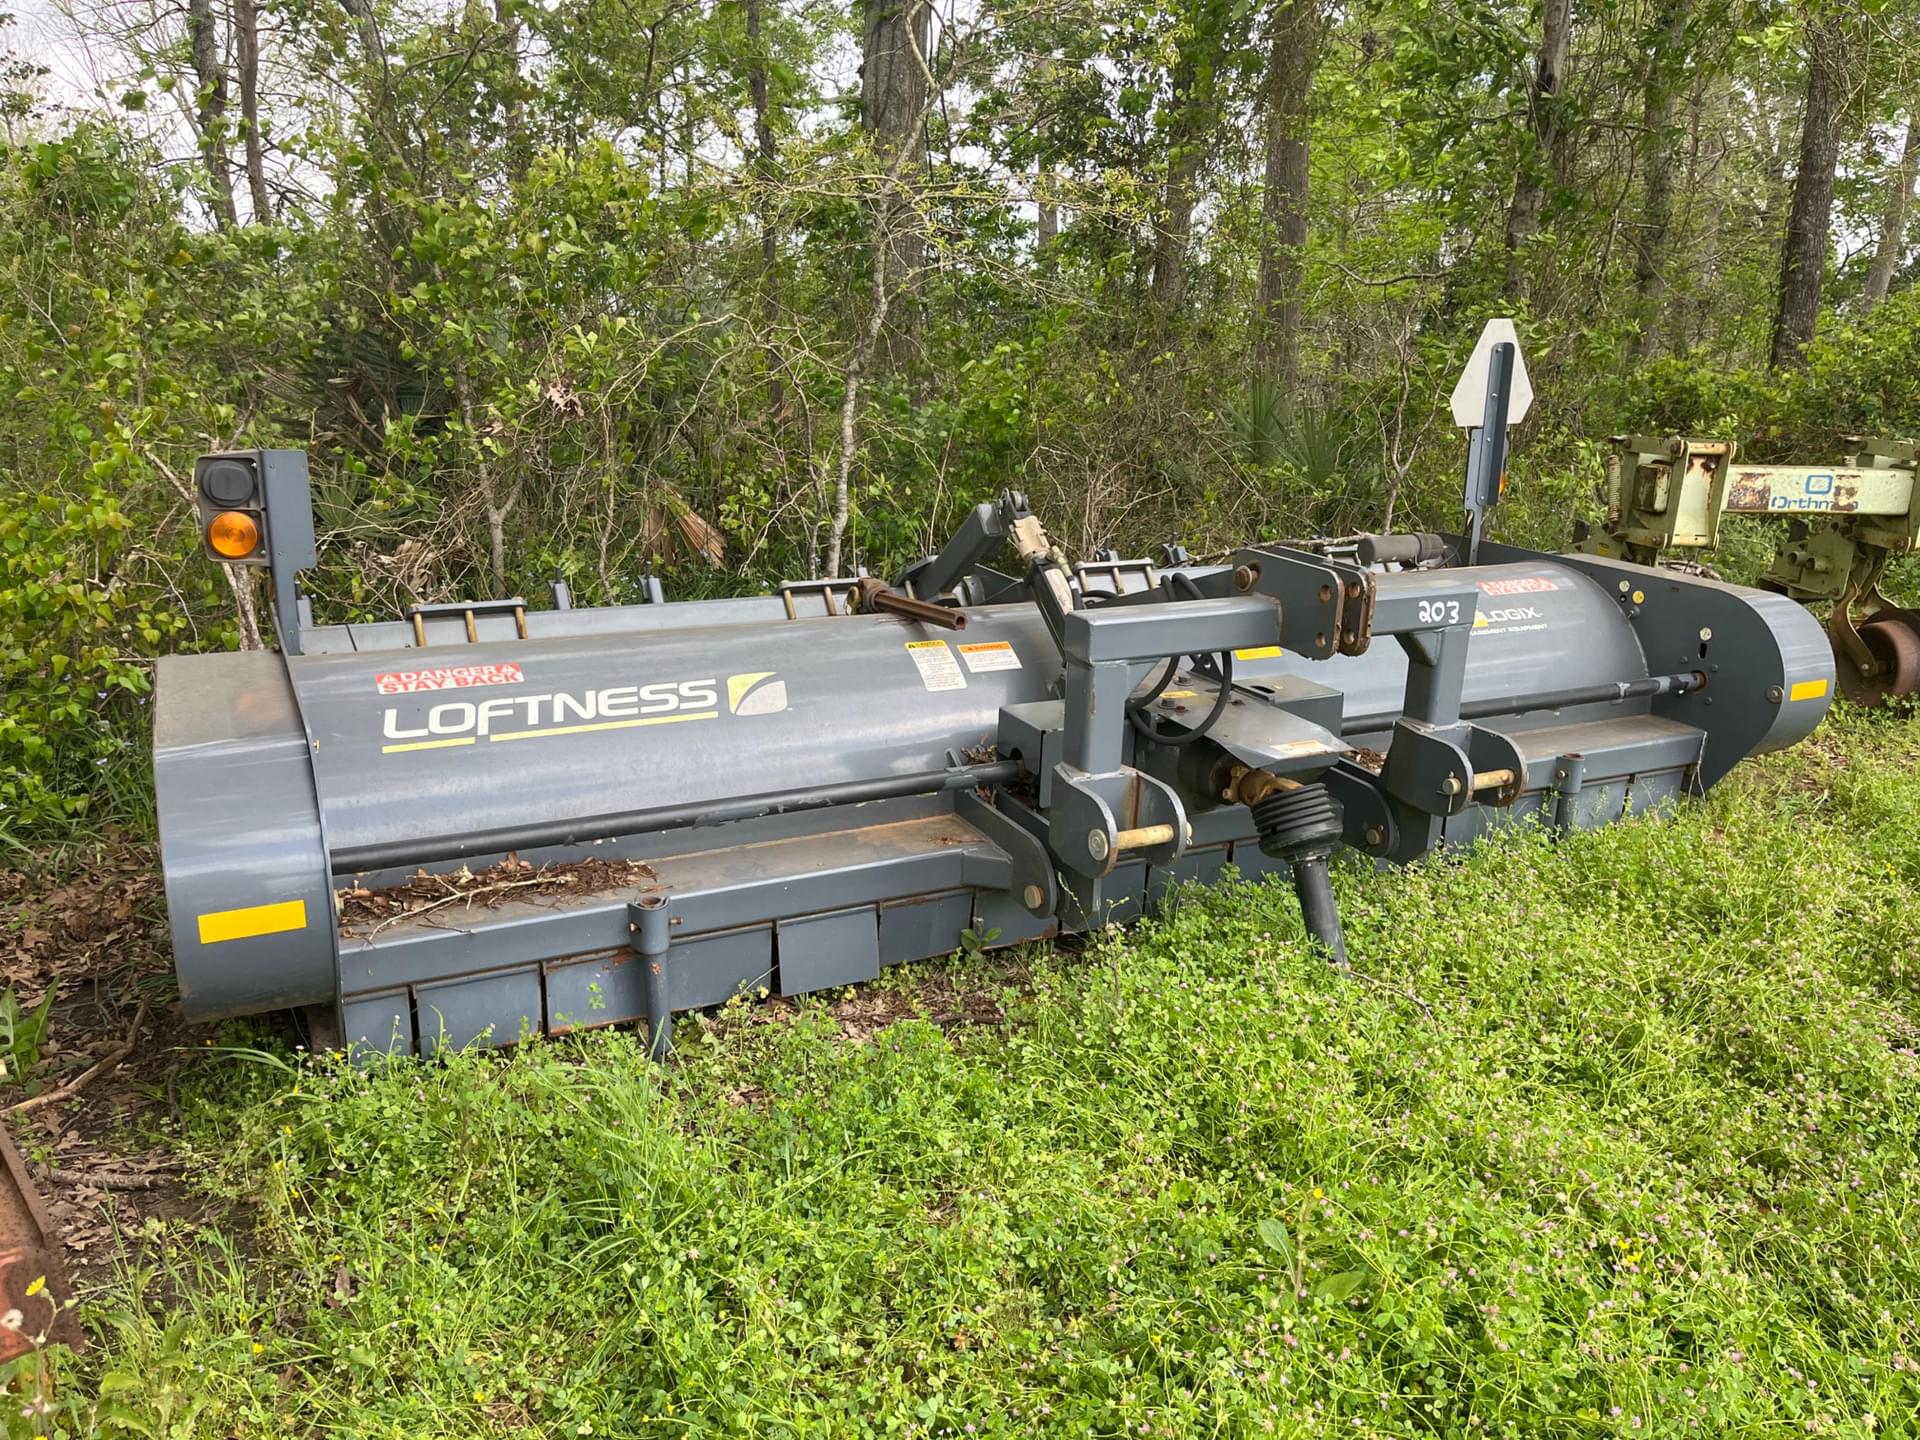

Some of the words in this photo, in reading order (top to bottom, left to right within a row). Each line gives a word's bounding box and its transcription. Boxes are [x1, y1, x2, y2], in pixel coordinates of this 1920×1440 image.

[1771, 496, 1859, 509] Orthmn
[1418, 600, 1460, 624] 203
[1485, 607, 1542, 622] LOGIX
[400, 665, 497, 681] DANGER
[383, 680, 446, 693] STAY
[455, 672, 519, 687] BACK
[382, 679, 718, 739] LOFTNESS
